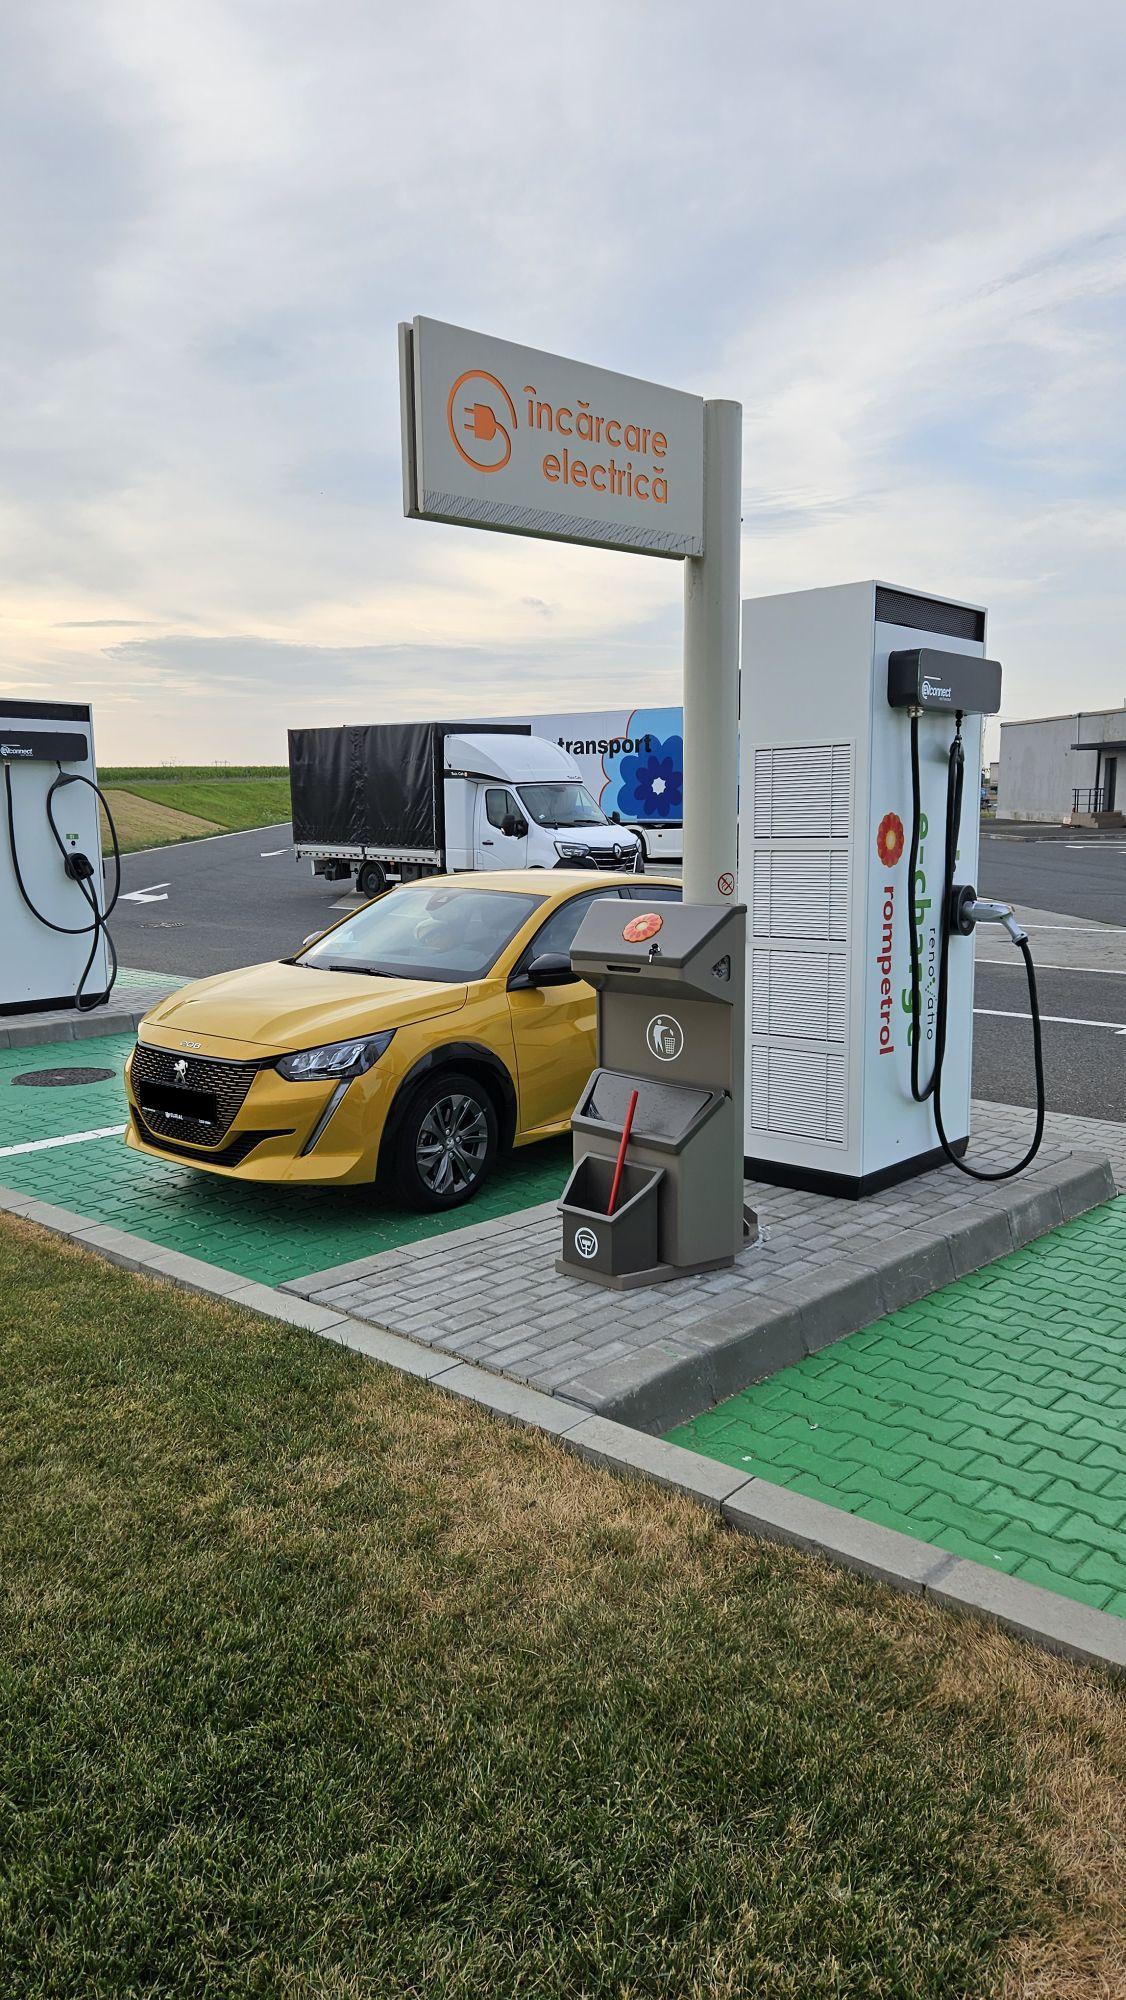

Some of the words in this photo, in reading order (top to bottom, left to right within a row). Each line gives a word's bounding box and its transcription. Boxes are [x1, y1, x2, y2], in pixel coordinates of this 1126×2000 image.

[523, 386, 667, 457] încărcare
[543, 449, 668, 504] electrică
[877, 886, 894, 1055] rompetrol
